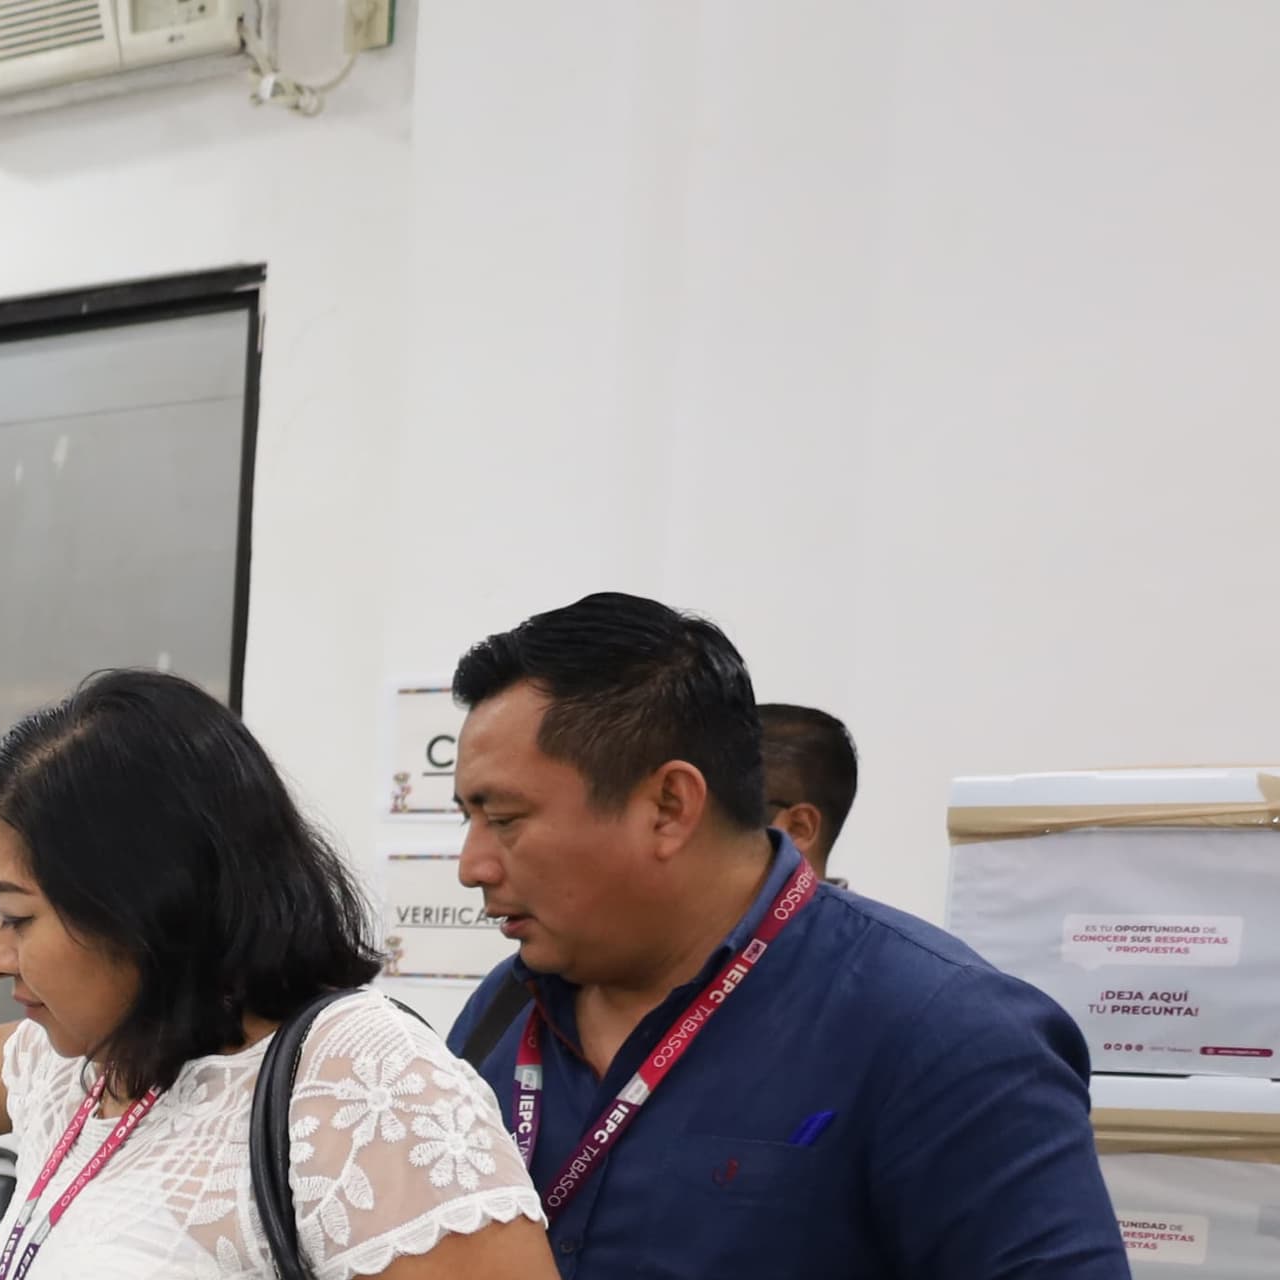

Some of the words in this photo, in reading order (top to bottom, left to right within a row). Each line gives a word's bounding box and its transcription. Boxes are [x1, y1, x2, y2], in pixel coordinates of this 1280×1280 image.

[1115, 925, 1200, 934] OPORTUNIDAD
[1116, 946, 1190, 954] PROPUESTAS
[709, 963, 748, 1004] IEPC
[1100, 990, 1144, 1002] ¡DEJA
[1148, 990, 1189, 1003] AQUÍ
[1088, 1004, 1106, 1014] TU
[1111, 1005, 1199, 1017] PREGUNTA!
[653, 1005, 714, 1068] TABASCO
[116, 1099, 148, 1138] IEPC
[518, 1095, 535, 1134] IEPC
[594, 1104, 630, 1144] IEPC
[61, 1143, 113, 1207] TABASCO
[548, 1145, 600, 1208] TABASCO
[1123, 1231, 1195, 1242] RESPUESTAS
